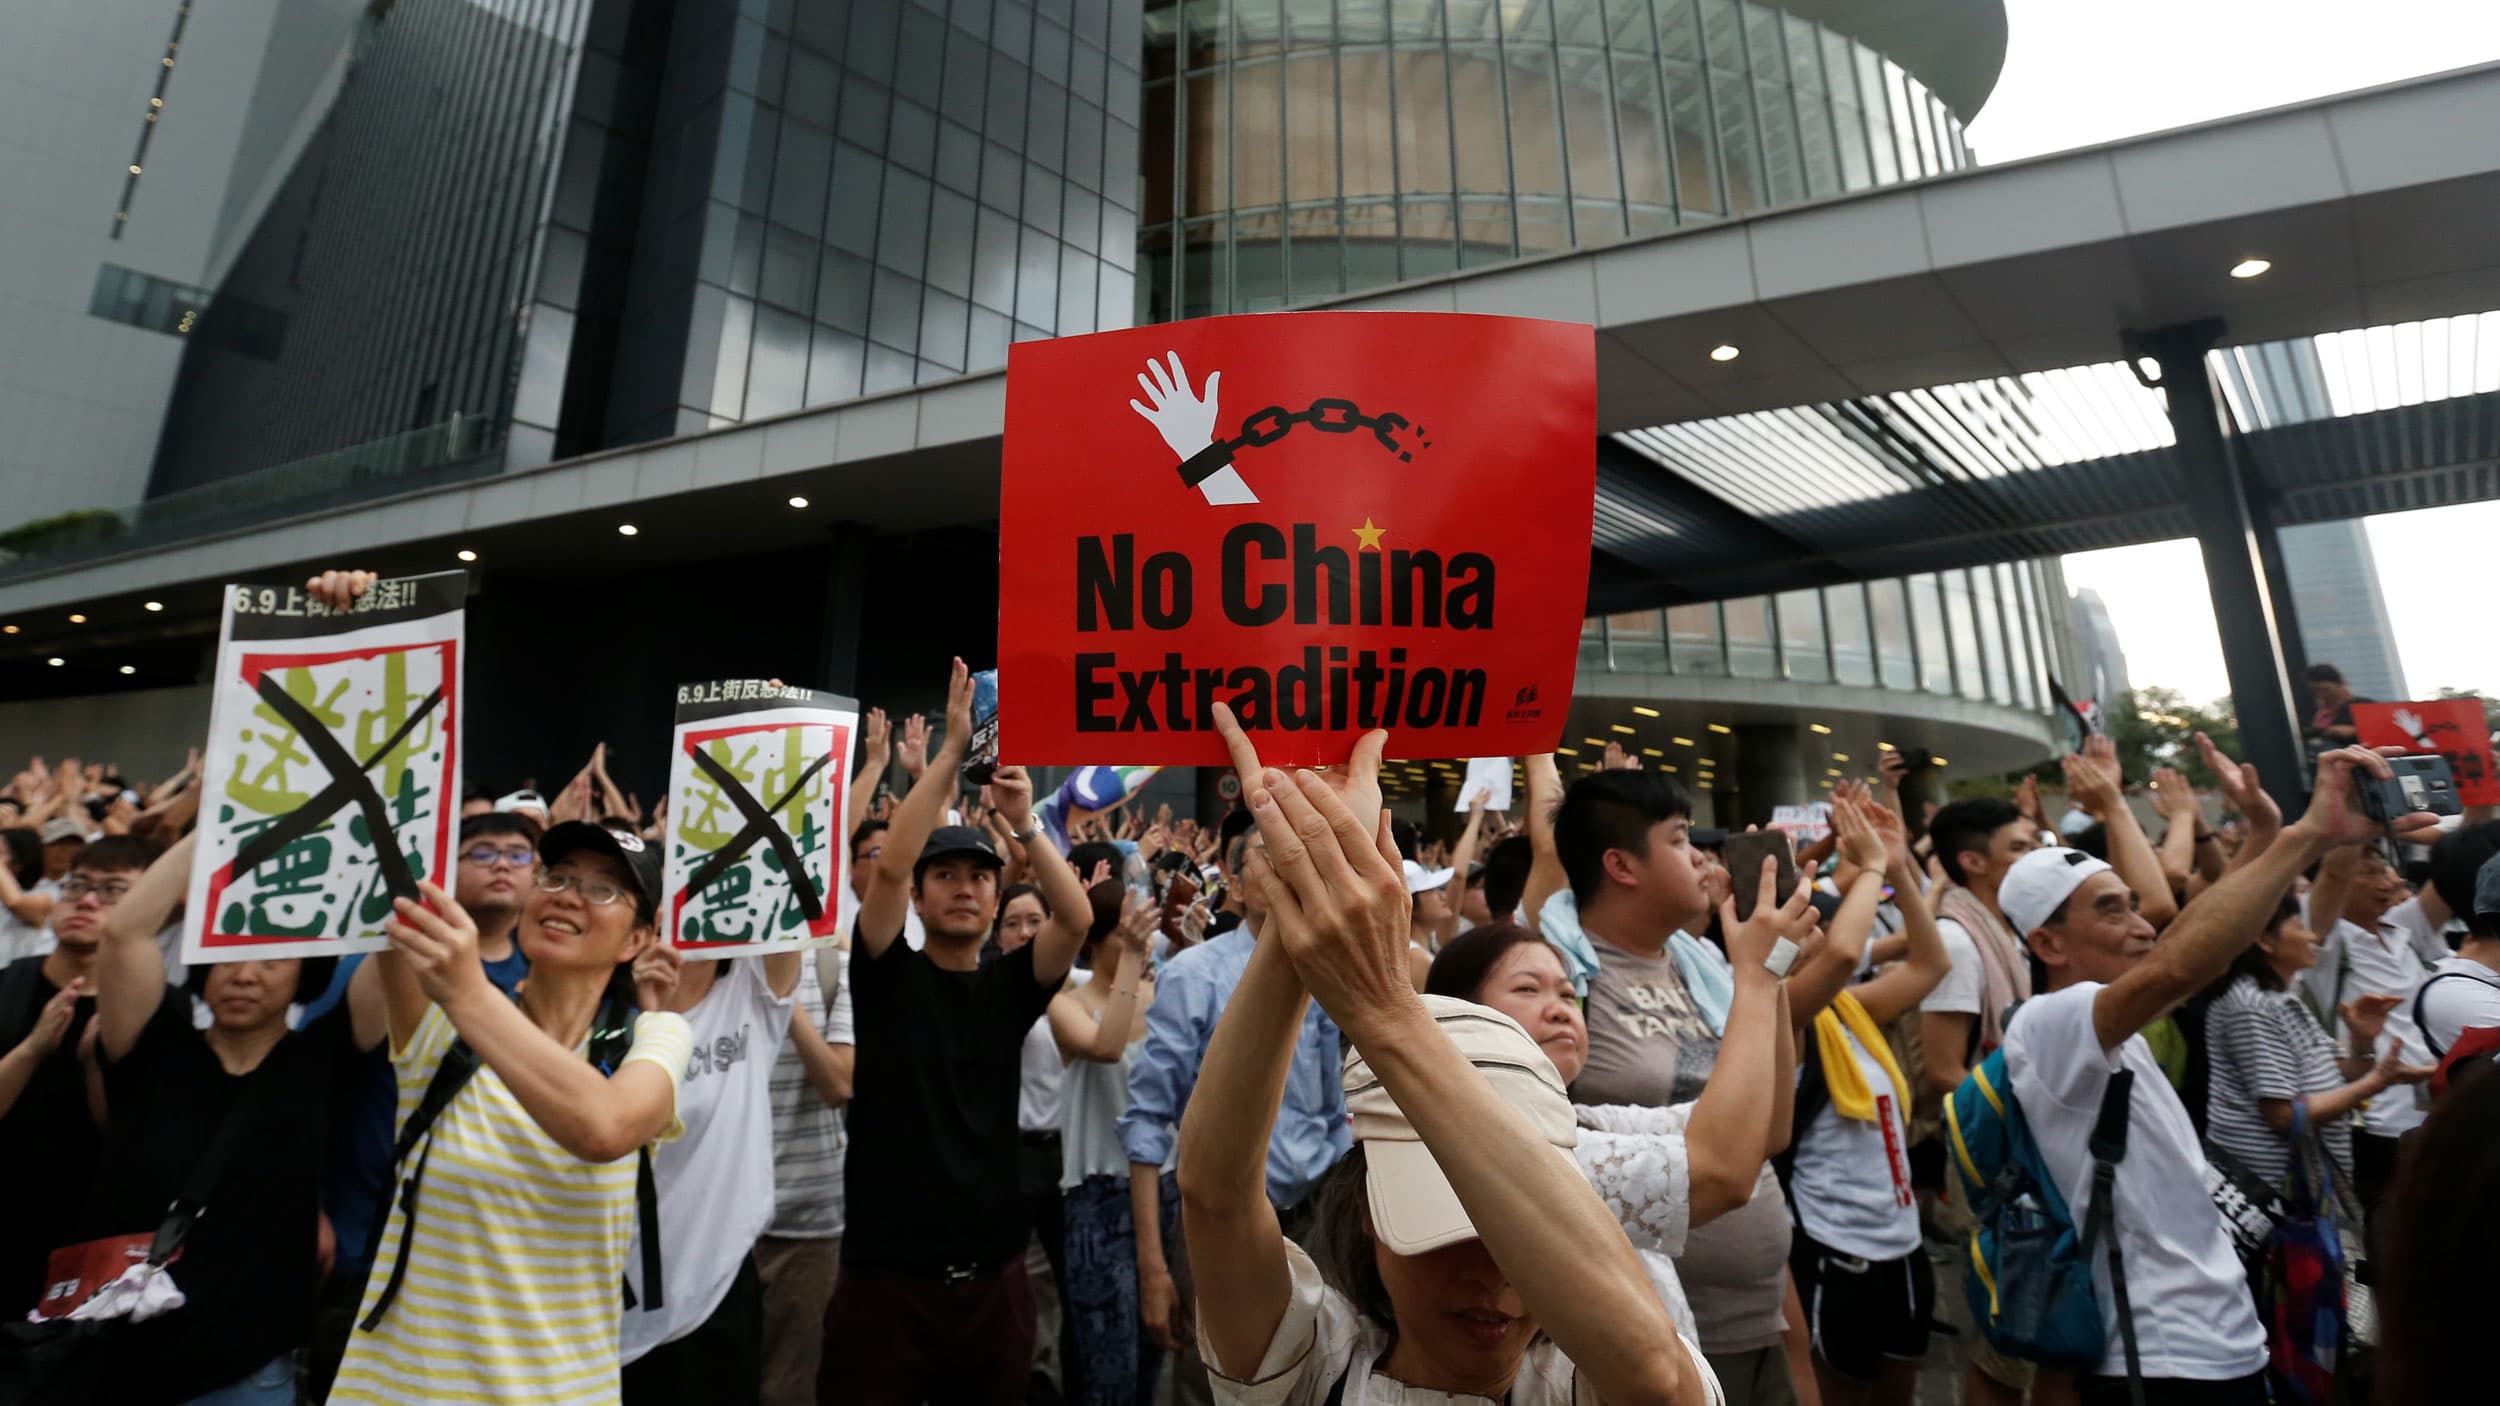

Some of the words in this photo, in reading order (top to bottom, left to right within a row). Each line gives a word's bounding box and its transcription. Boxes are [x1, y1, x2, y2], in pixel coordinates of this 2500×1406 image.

[1076, 532, 1193, 632] No
[1221, 519, 1495, 630] China
[1075, 646, 1487, 732] Extradition
